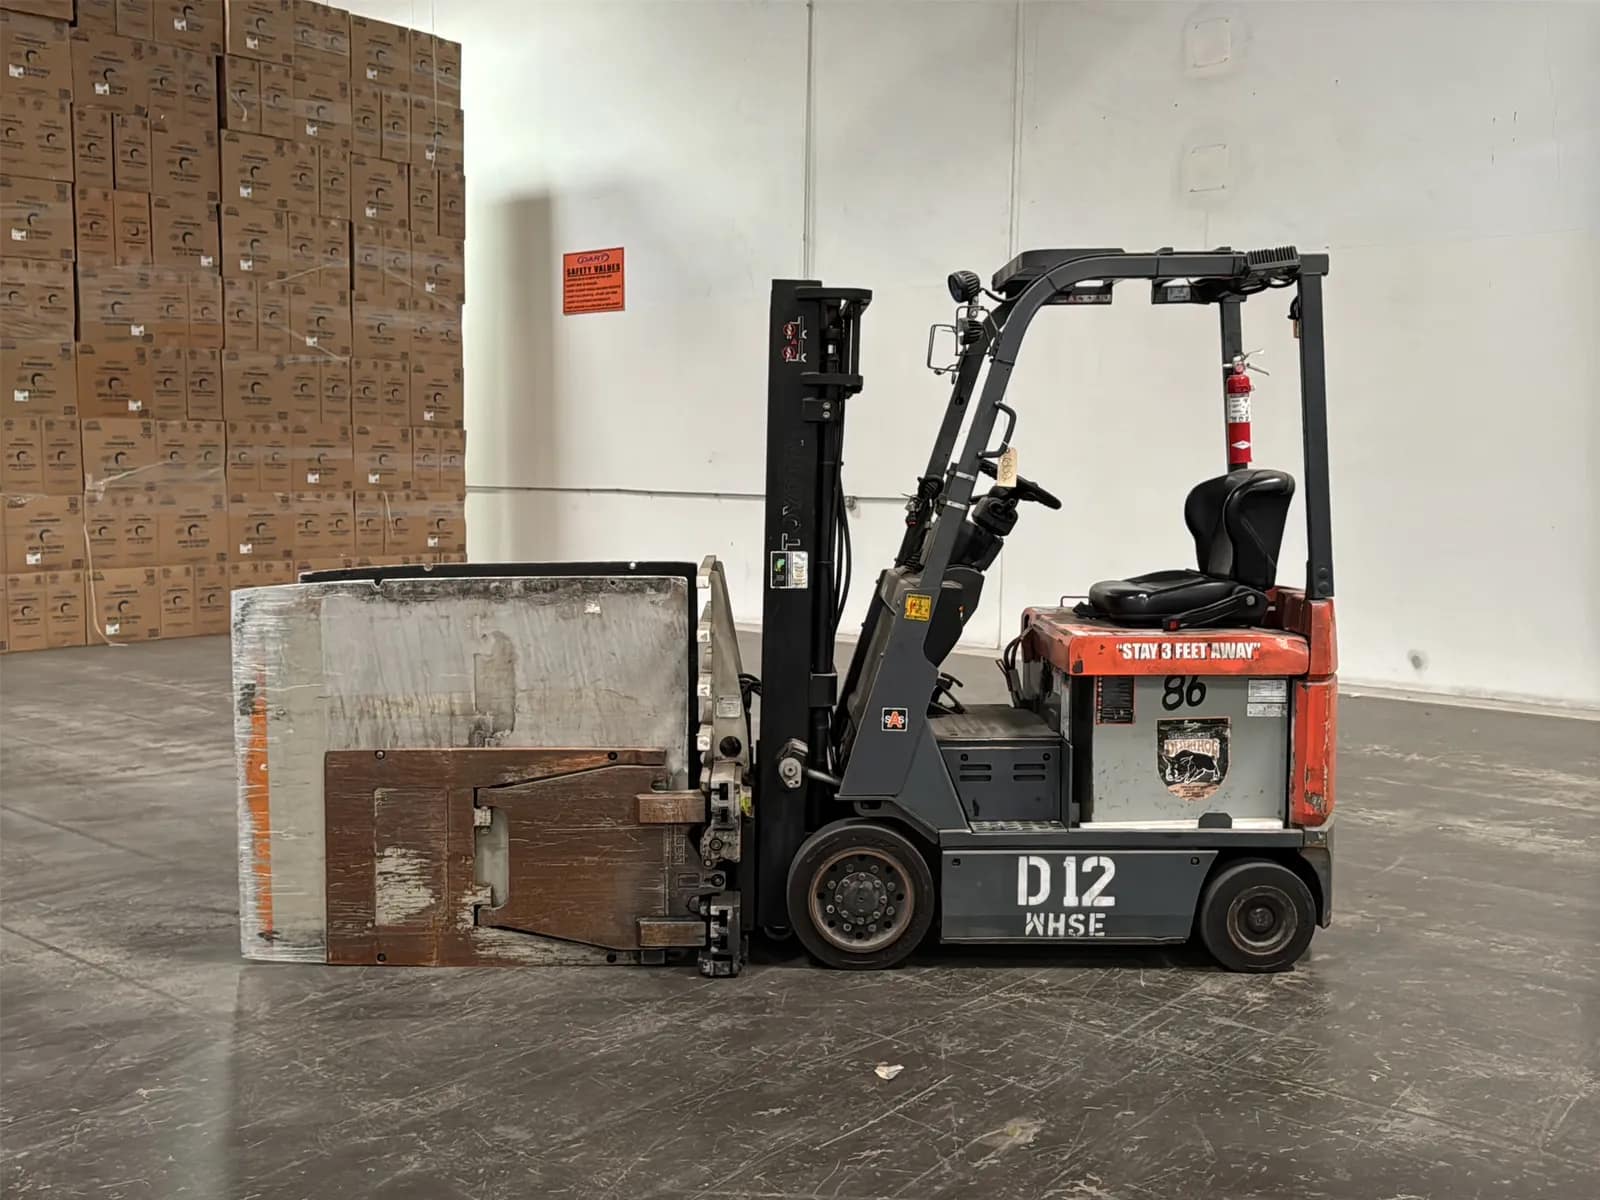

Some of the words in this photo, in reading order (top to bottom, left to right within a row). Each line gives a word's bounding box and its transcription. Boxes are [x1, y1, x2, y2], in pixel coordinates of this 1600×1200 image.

[567, 266, 592, 276] SAFETY
[593, 263, 621, 273] VALUES
[1162, 643, 1172, 660] 3
[1175, 643, 1208, 660] FEET
[1162, 675, 1206, 711] 86
[1024, 912, 1106, 936] WHSE
